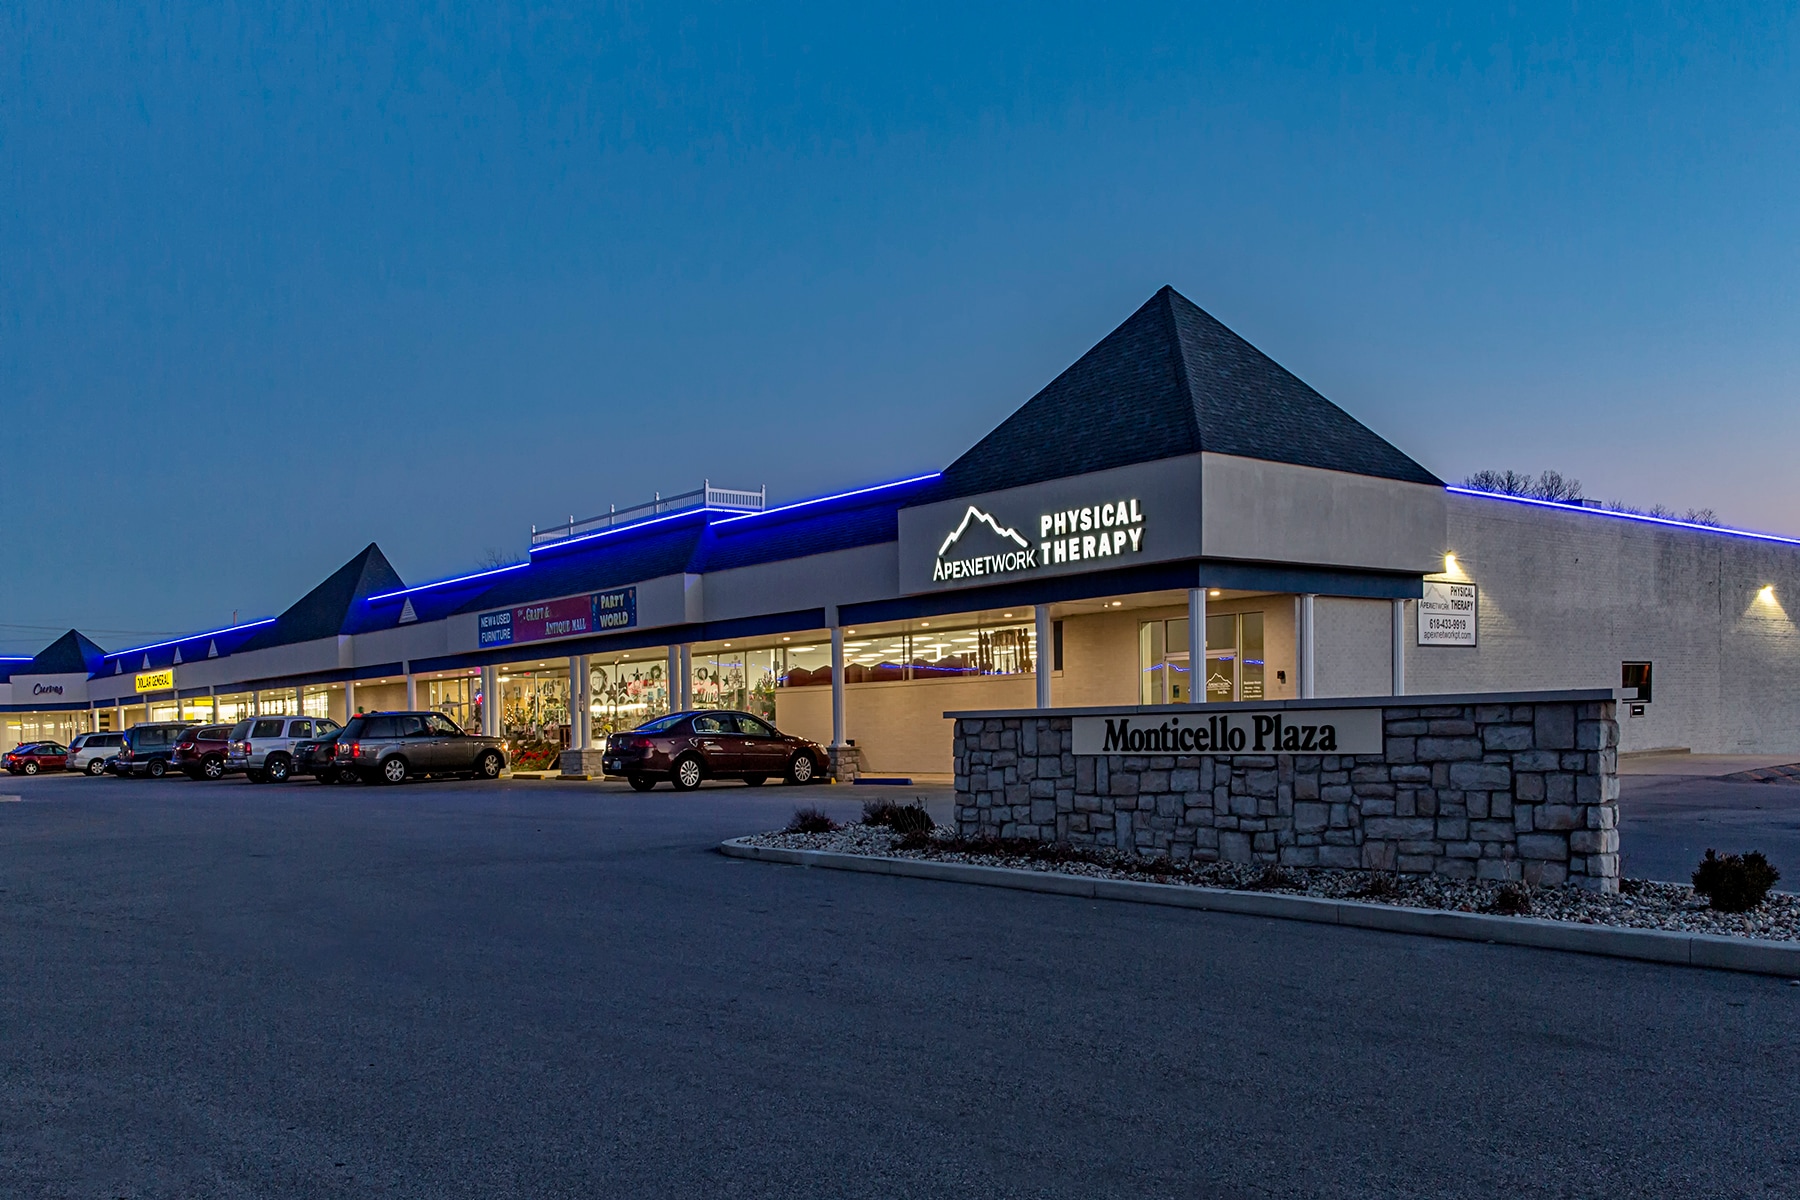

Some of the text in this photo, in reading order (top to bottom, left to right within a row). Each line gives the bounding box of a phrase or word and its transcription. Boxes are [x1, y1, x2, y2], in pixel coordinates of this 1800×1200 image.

[1041, 499, 1142, 538] PHYSICAL
[1041, 527, 1143, 565] THERAPY
[1450, 586, 1474, 598] PHYSICAL
[601, 593, 625, 609] PARTY
[1451, 600, 1474, 611] THERAPY
[544, 617, 586, 635] ANTIQUE MALL
[600, 611, 629, 628] WORLD
[481, 628, 511, 643] FURNITURE
[1102, 713, 1338, 752] Monticello Plaza
